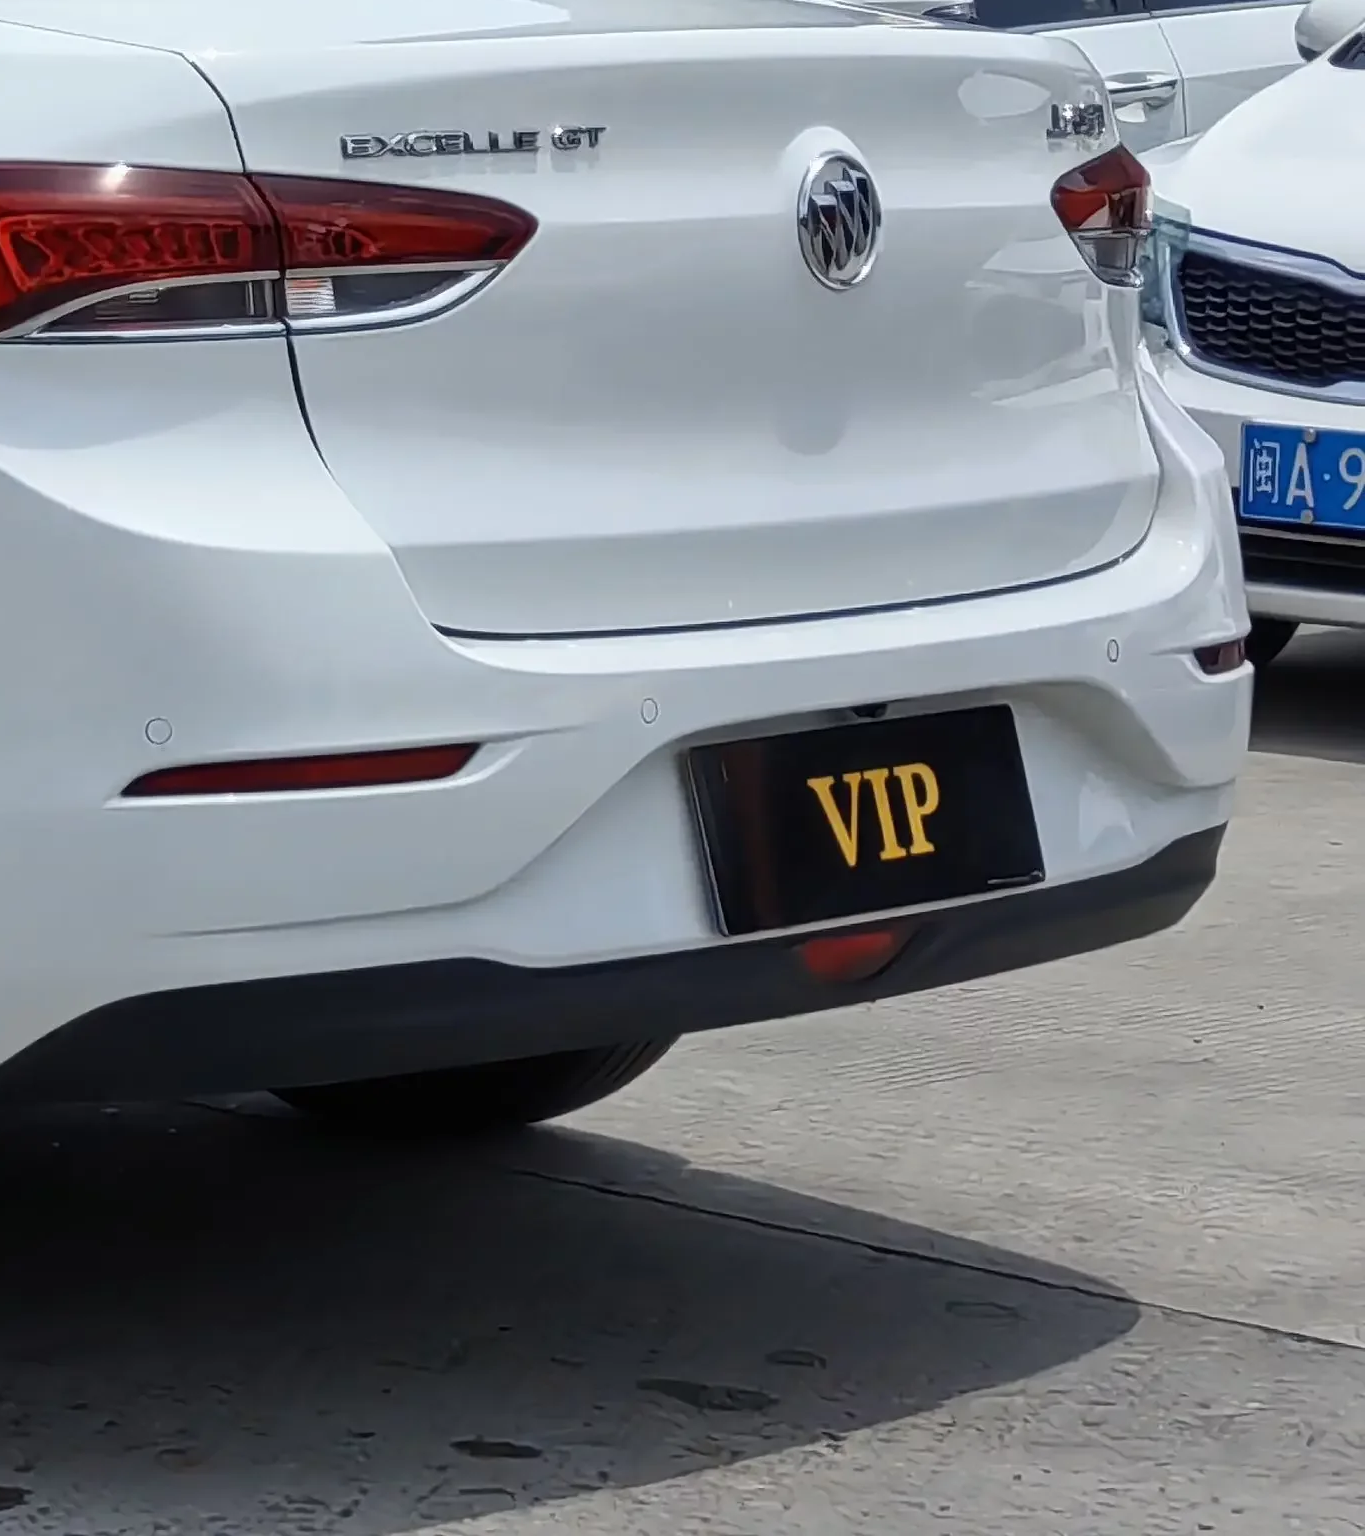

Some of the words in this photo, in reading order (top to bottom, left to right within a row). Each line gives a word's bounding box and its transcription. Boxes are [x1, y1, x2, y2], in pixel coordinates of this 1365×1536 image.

[340, 129, 541, 160] EXCELLE
[550, 124, 607, 151] GT
[806, 761, 941, 869] VIP
